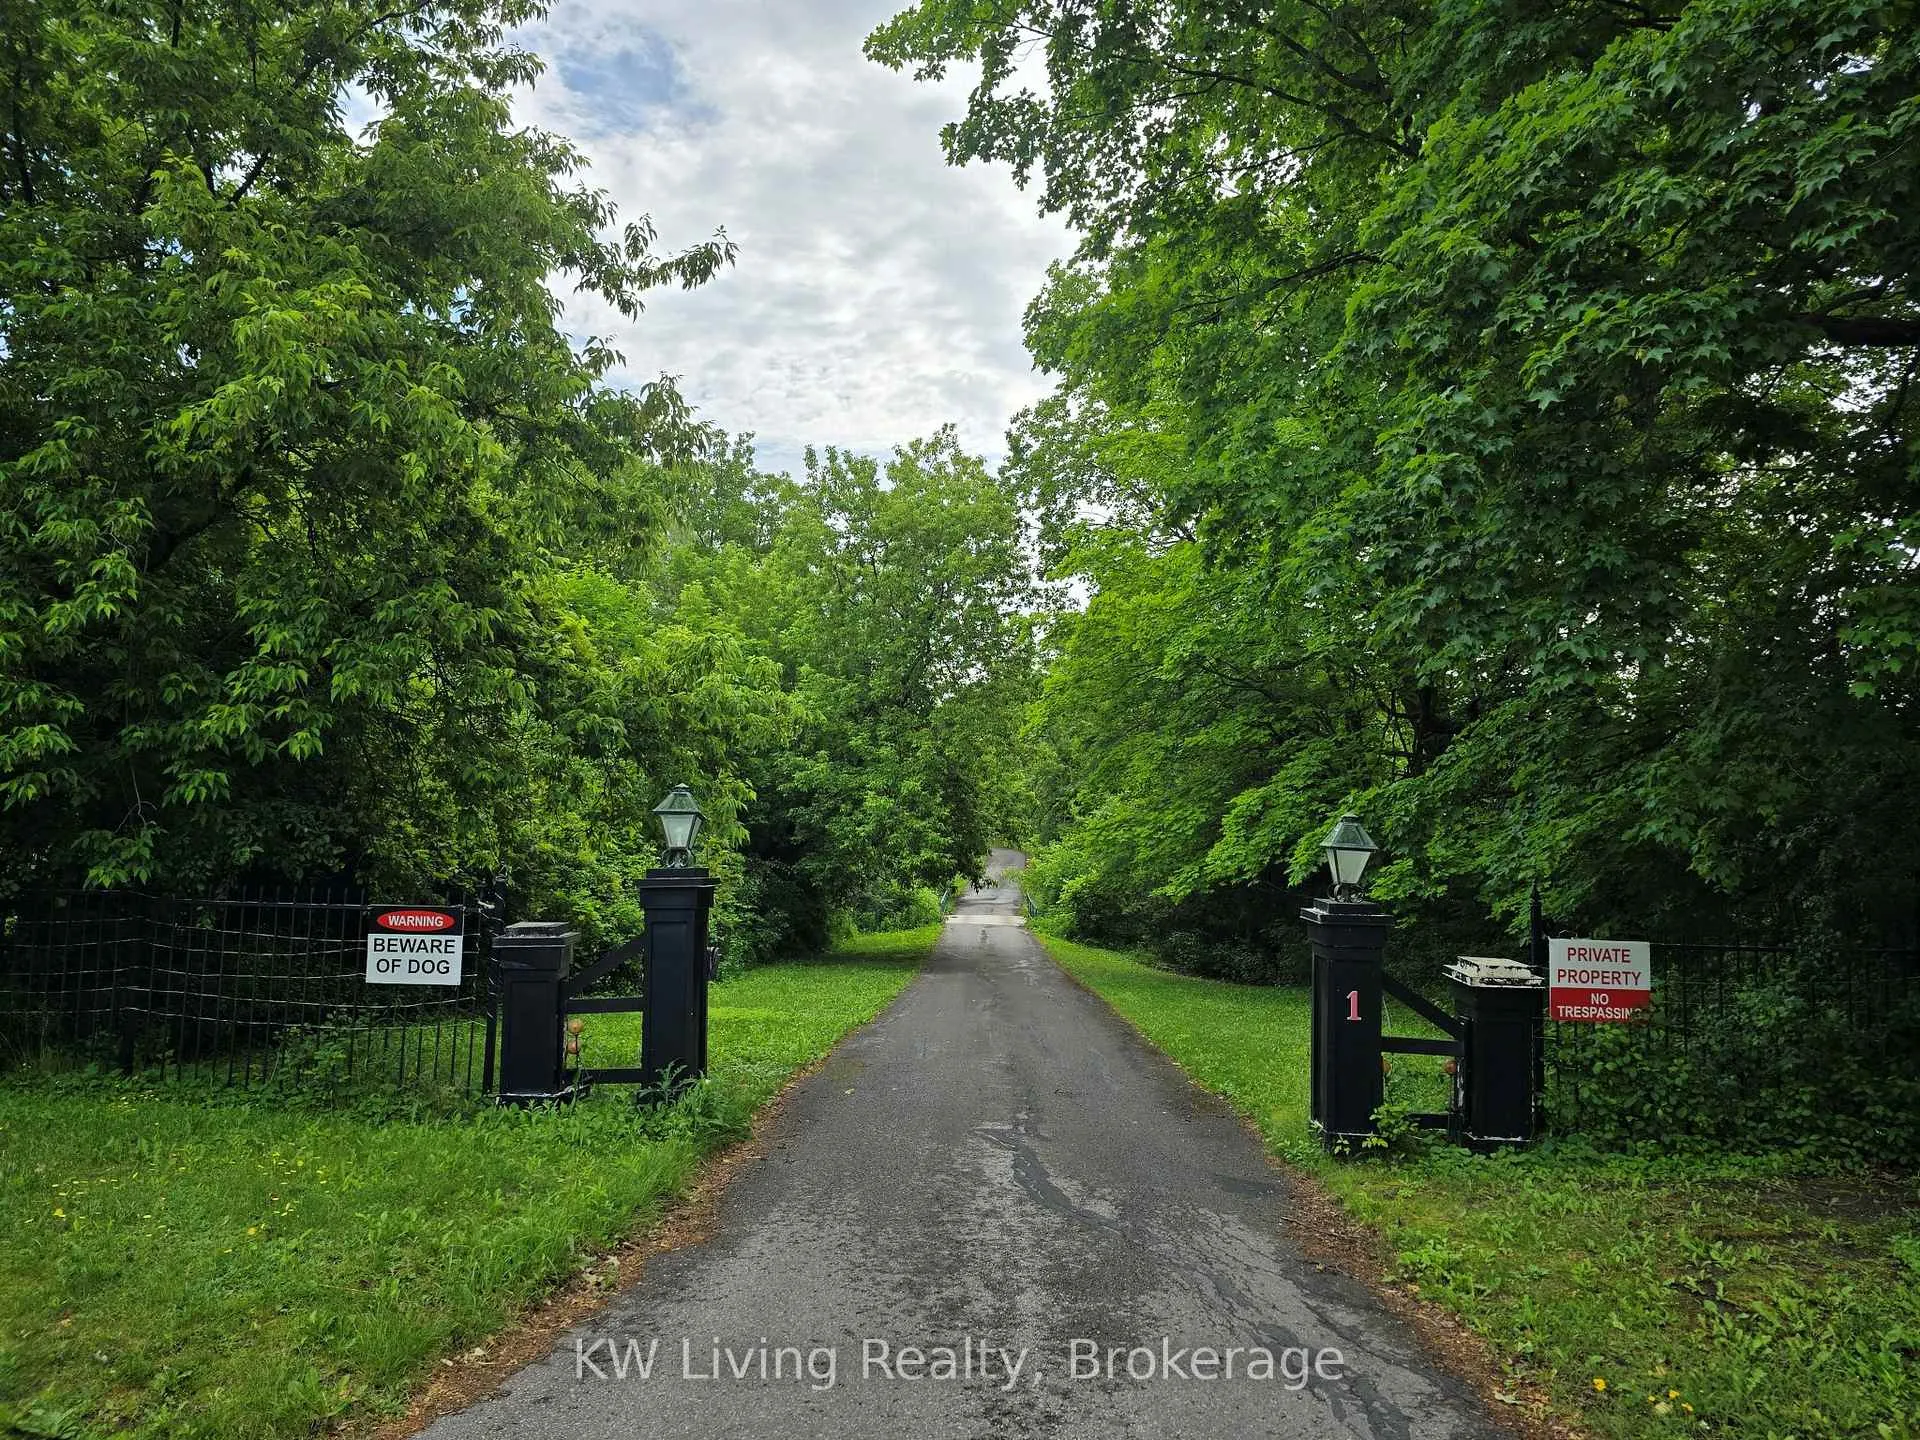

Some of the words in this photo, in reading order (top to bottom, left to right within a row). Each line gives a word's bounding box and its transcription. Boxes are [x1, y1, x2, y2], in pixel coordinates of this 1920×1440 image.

[388, 915, 444, 927] WARNING
[373, 938, 456, 954] BEWARE
[1567, 947, 1631, 963] PRIVATE
[376, 958, 402, 974] OF
[407, 959, 450, 975] DOG
[1557, 969, 1642, 986] PROPERTY
[1346, 990, 1362, 1021] 1
[1590, 993, 1609, 1005] NO
